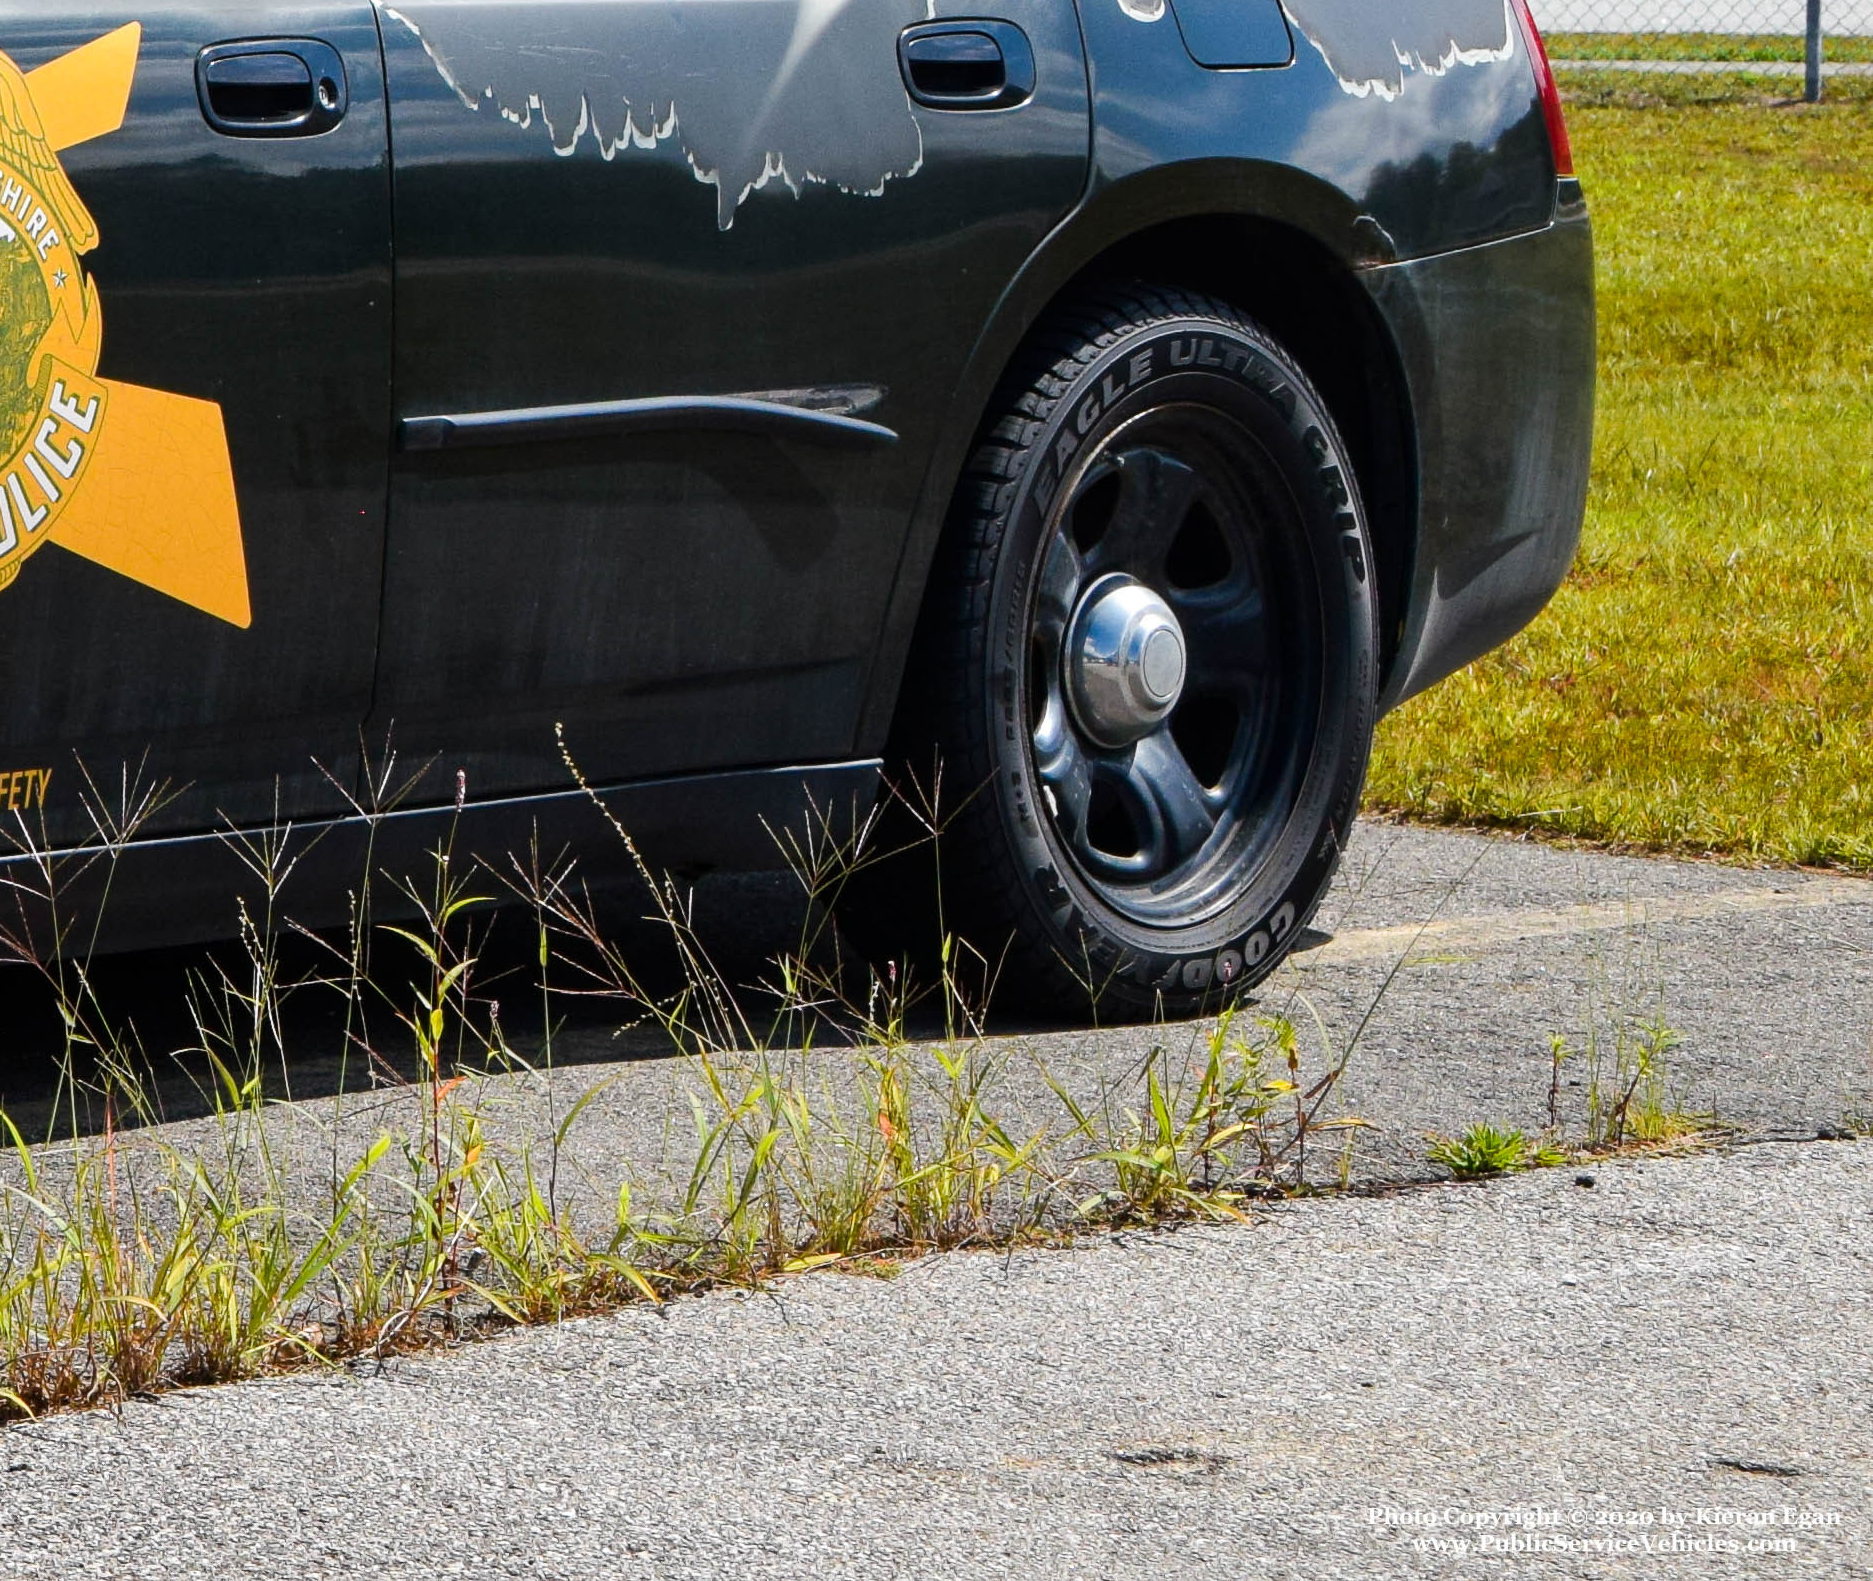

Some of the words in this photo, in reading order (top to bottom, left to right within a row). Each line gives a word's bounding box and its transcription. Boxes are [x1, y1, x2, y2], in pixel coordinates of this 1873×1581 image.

[1032, 348, 1157, 518] EAGLE
[1169, 338, 1297, 425] ULTRA
[1303, 425, 1367, 583] GRIP
